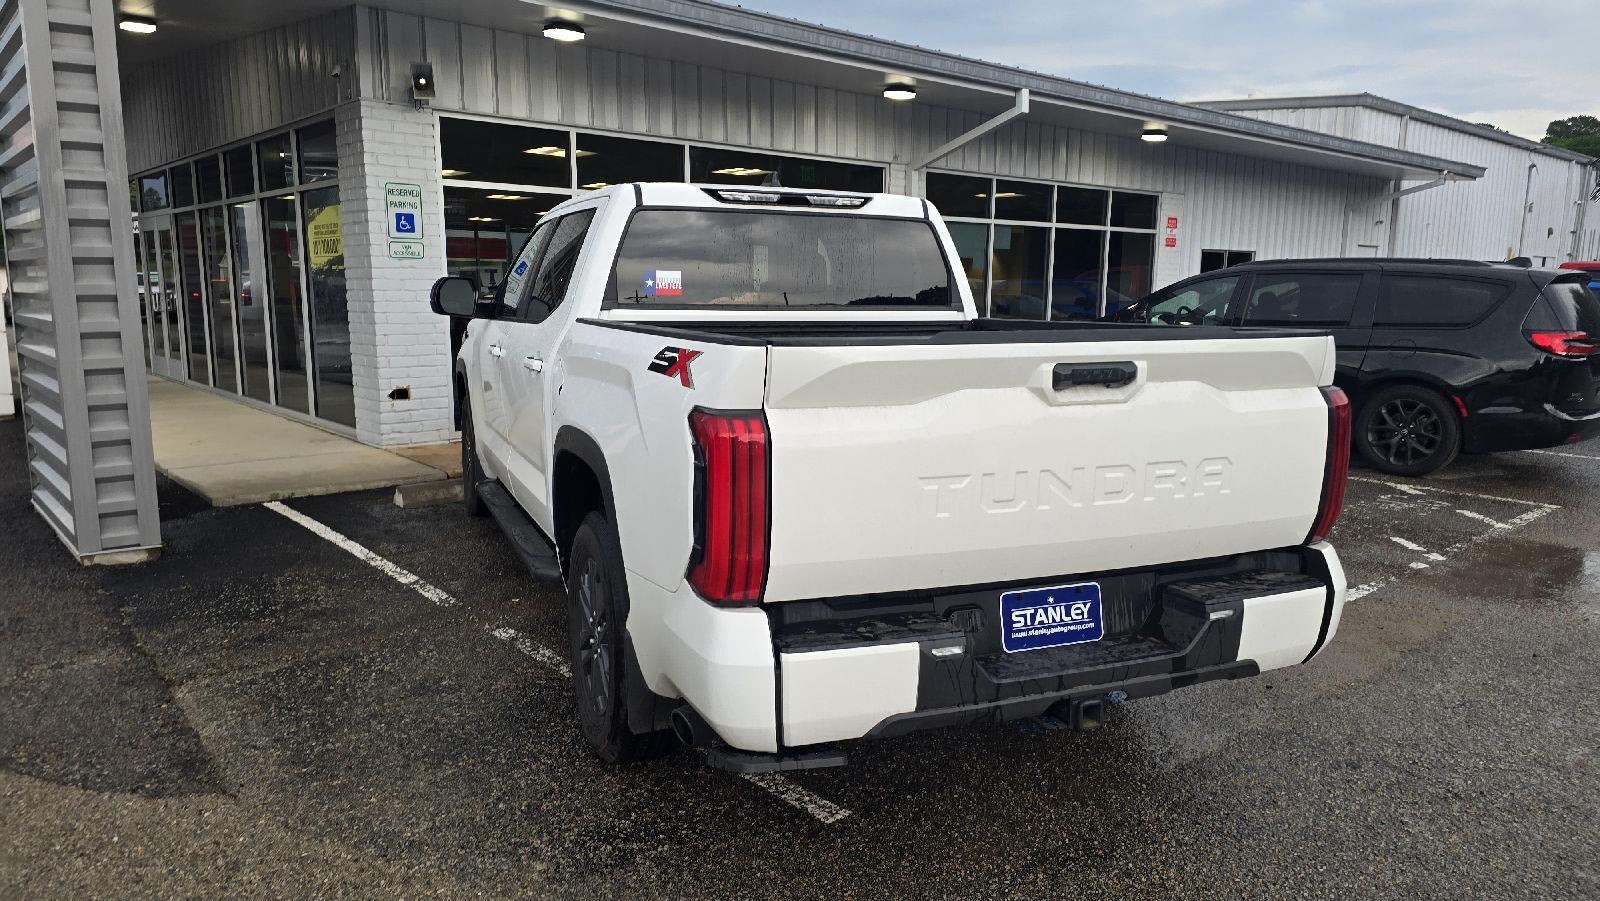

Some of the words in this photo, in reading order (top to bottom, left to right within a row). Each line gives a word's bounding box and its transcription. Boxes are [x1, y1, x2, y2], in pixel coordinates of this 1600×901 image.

[387, 188, 420, 198] RESERVED
[389, 200, 418, 210] PARKING
[647, 346, 704, 390] SX
[918, 457, 1232, 517] TUNDRA
[1011, 602, 1092, 628] STANLEY
[1011, 622, 1095, 639] www.stanleyautogroup.com
